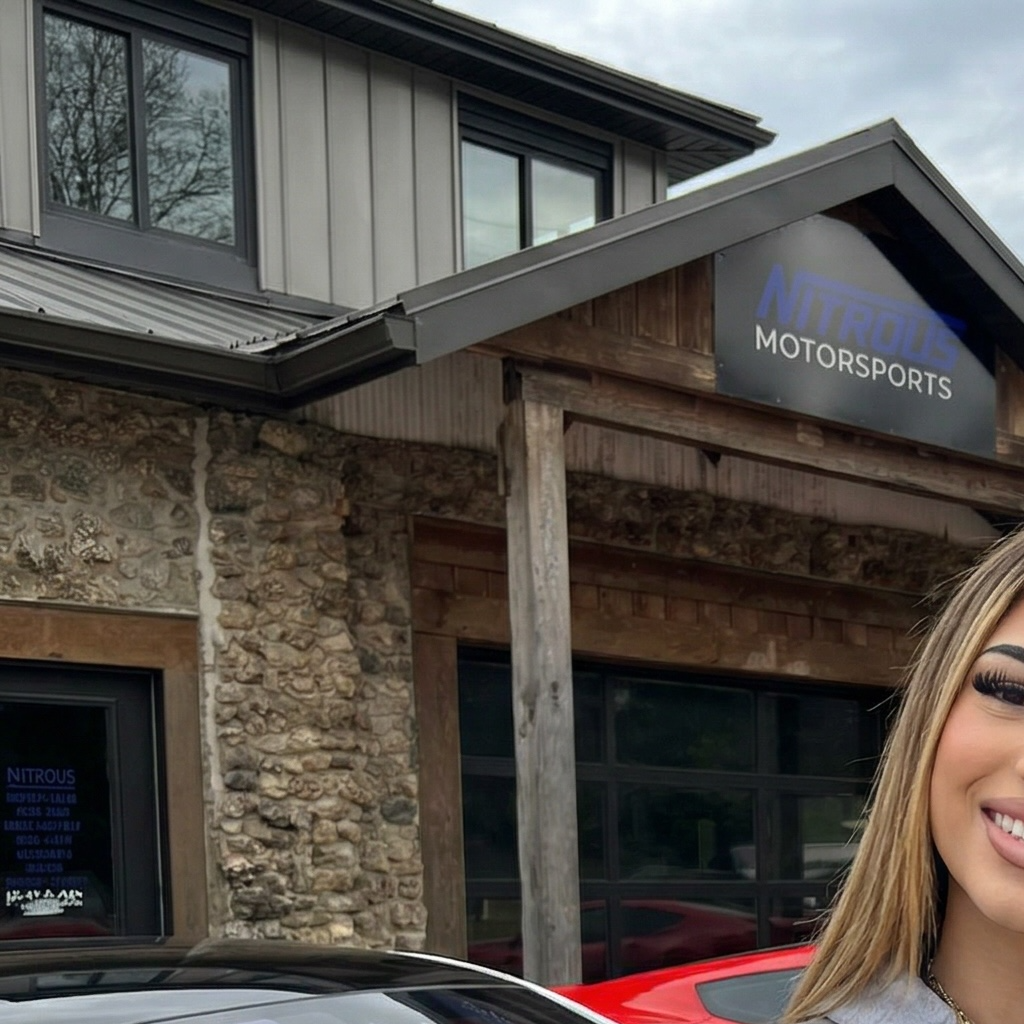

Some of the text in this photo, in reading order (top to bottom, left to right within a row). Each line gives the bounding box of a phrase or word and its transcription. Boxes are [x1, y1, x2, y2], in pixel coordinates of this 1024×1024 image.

[756, 264, 968, 371] NITROUS
[755, 324, 952, 400] MOTORSPORTS
[7, 767, 76, 785] NITROUS
